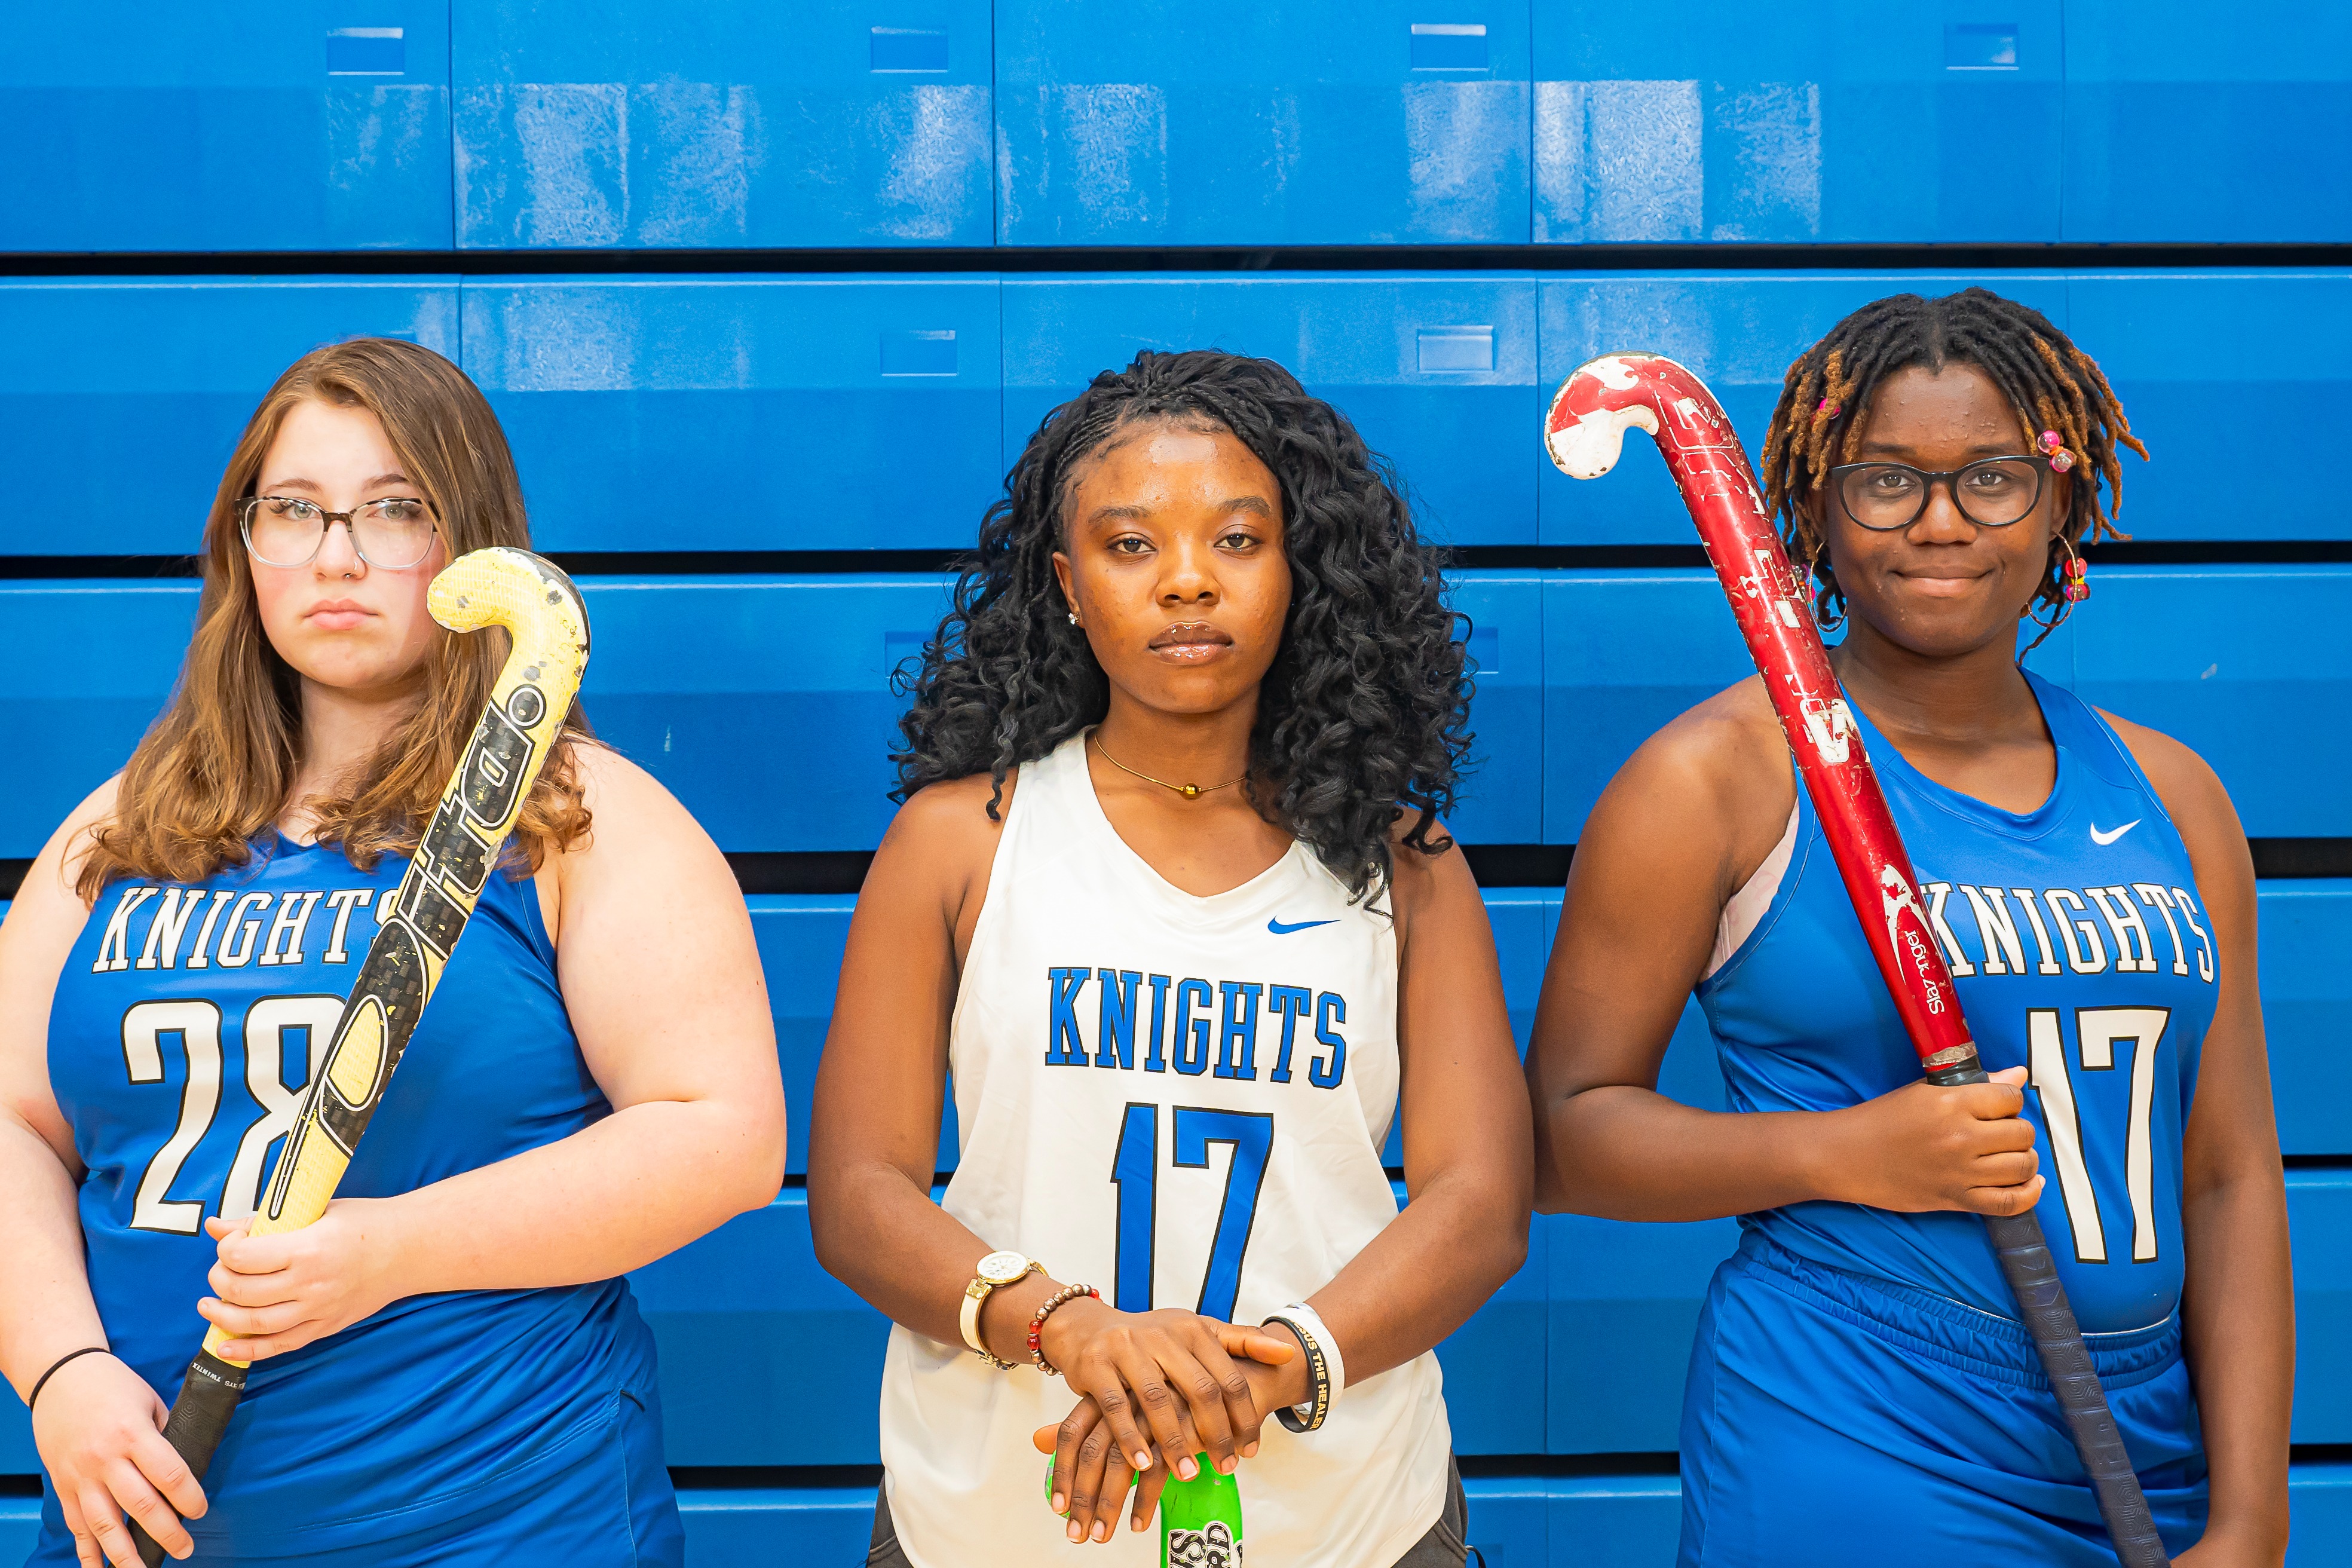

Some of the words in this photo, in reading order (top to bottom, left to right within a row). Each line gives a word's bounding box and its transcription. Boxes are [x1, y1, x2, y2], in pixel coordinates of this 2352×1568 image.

[1921, 883, 2215, 984] KNIGHTS
[1045, 966, 1346, 1090] KNIGHTS
[121, 993, 348, 1237] 28
[2026, 1005, 2172, 1264] 17
[1110, 1101, 1274, 1324] 17
[192, 1362, 222, 1382] TWINTEX
[1309, 1383, 1327, 1429] HEALER
[1312, 1352, 1326, 1381] THE
